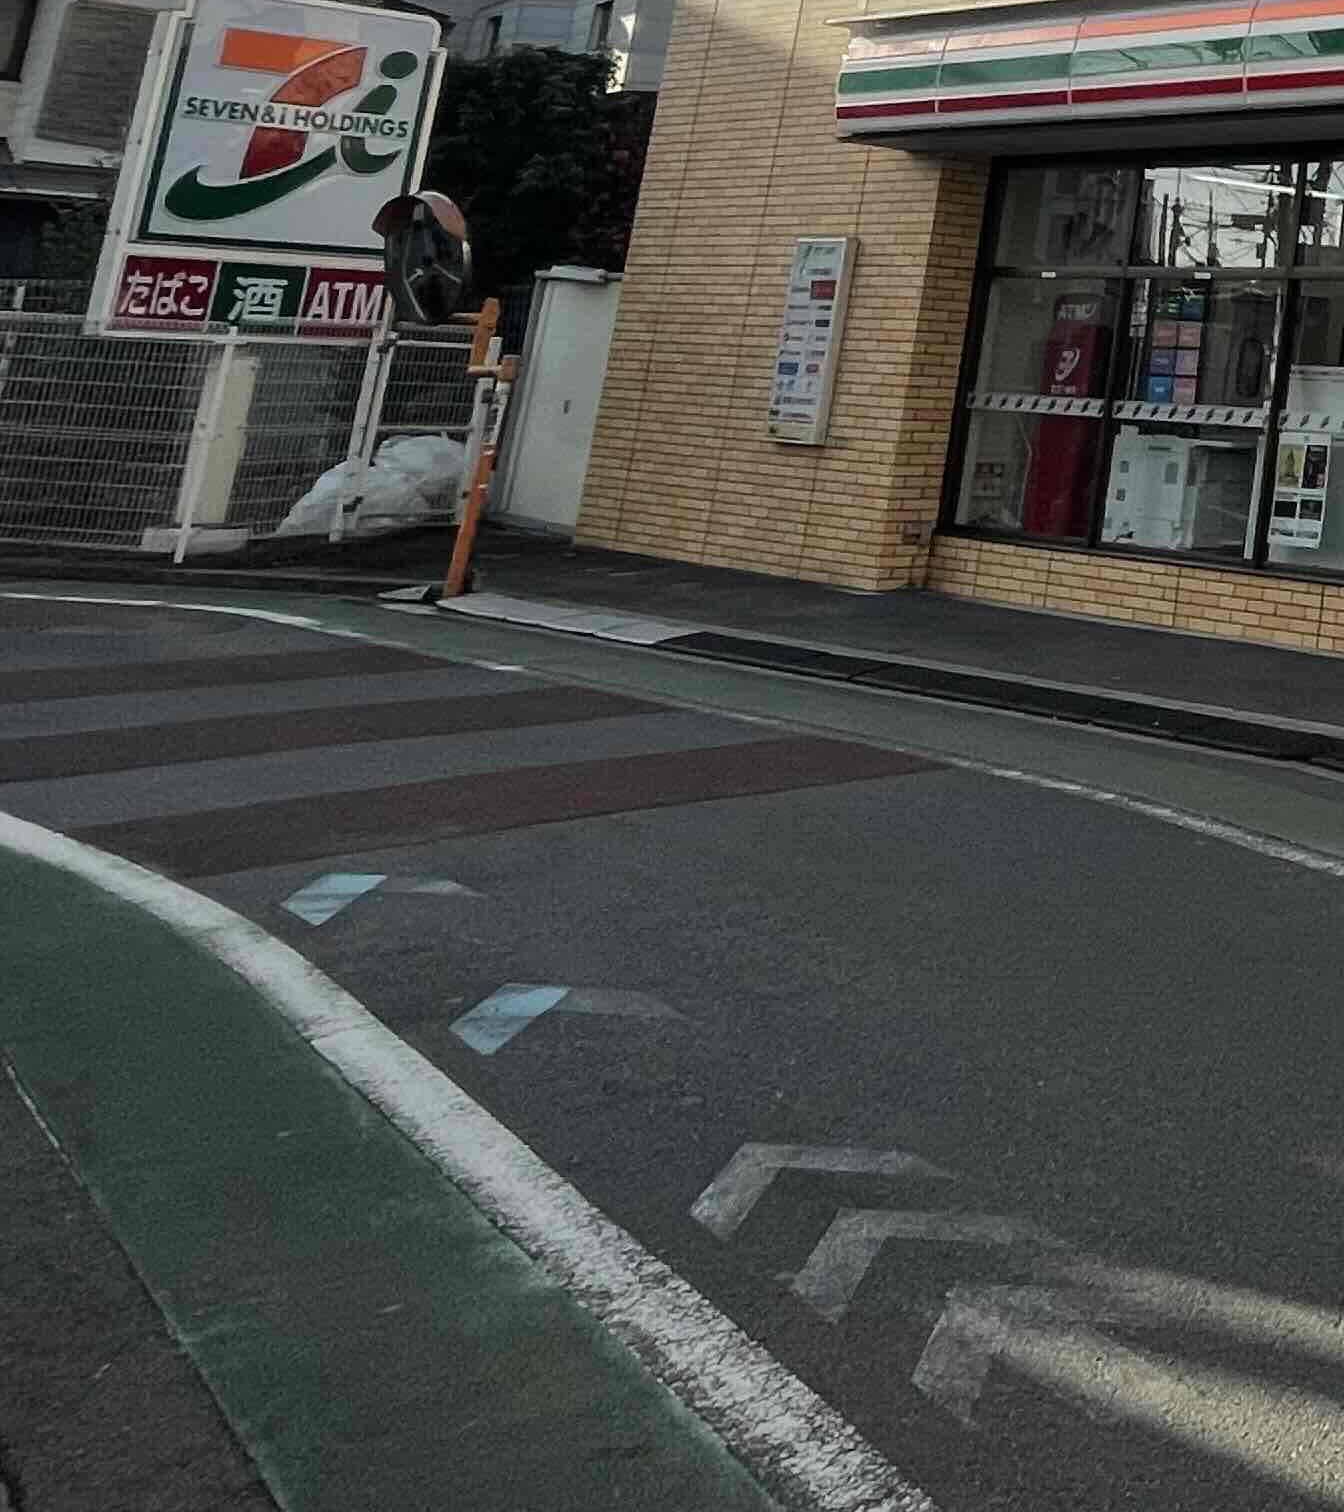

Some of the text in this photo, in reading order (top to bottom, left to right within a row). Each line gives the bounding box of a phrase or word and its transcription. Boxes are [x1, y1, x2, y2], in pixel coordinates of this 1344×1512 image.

[293, 110, 409, 138] HOLDINGS
[119, 269, 385, 326] たばこ 酒 ATM
